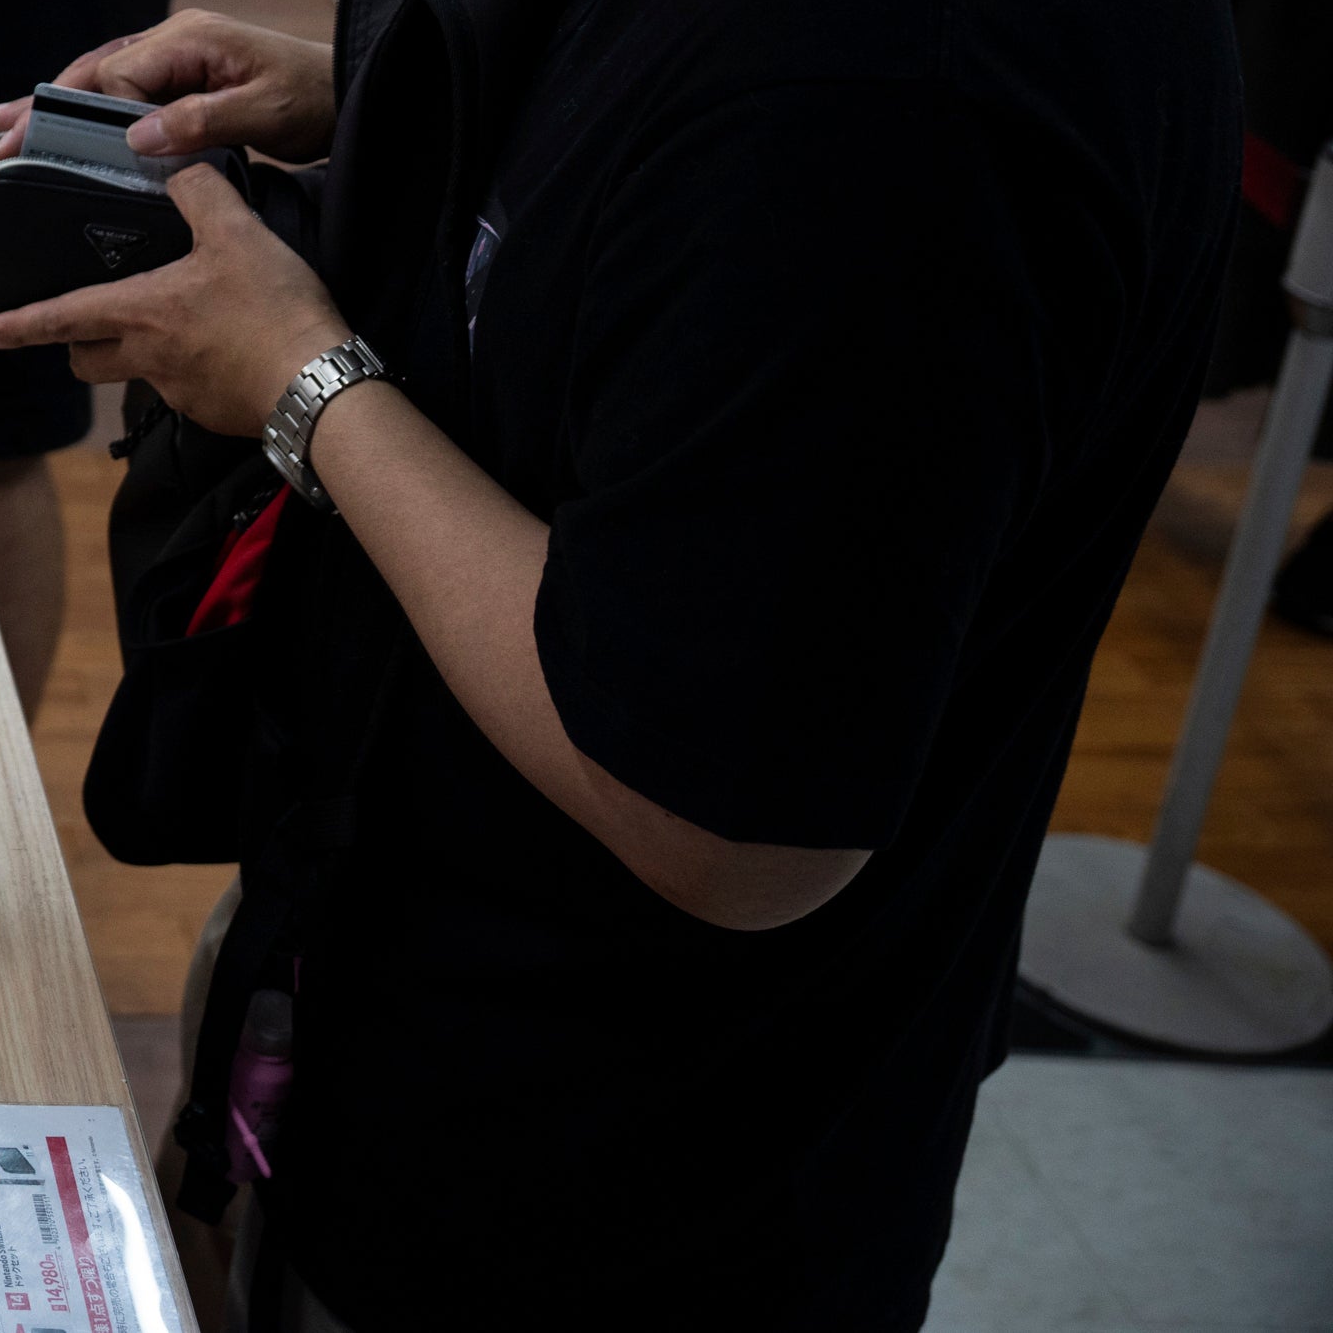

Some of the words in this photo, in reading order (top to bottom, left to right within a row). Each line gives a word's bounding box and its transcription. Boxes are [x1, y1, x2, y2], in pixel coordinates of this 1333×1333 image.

[1, 1255, 13, 1288] Nintendo
[39, 1254, 65, 1304] 14,980円
[11, 1295, 24, 1307] 14
